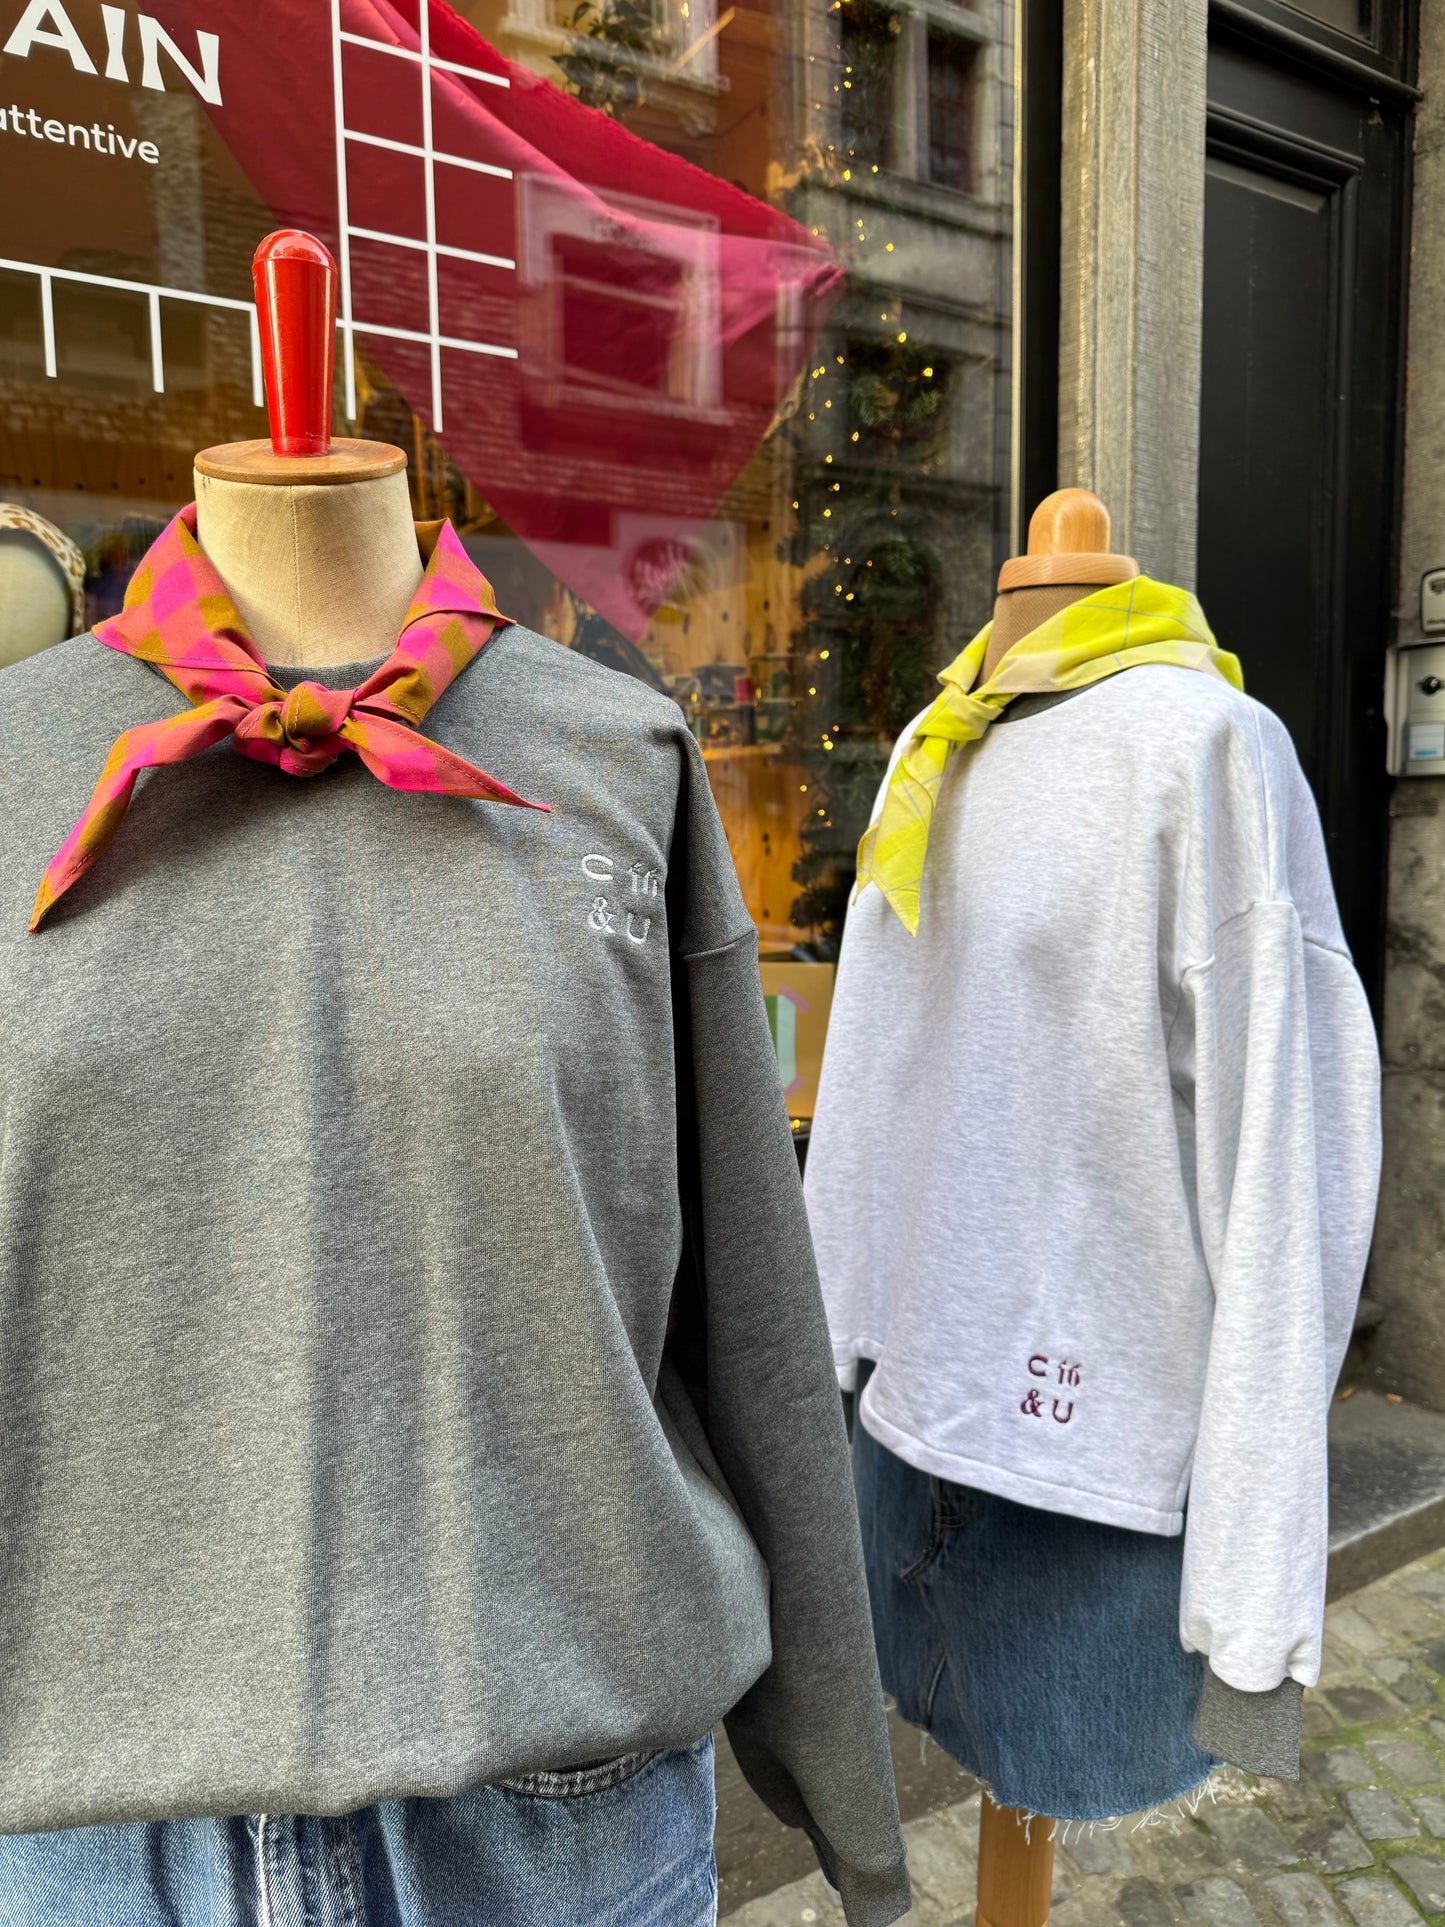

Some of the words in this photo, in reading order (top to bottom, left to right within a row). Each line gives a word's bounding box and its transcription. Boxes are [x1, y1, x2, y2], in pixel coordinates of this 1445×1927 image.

[581, 853, 614, 881] C
[587, 896, 617, 934] &
[626, 912, 651, 944] U
[1028, 1354, 1049, 1377] C
[1020, 1388, 1044, 1418] &
[1052, 1398, 1074, 1424] U
